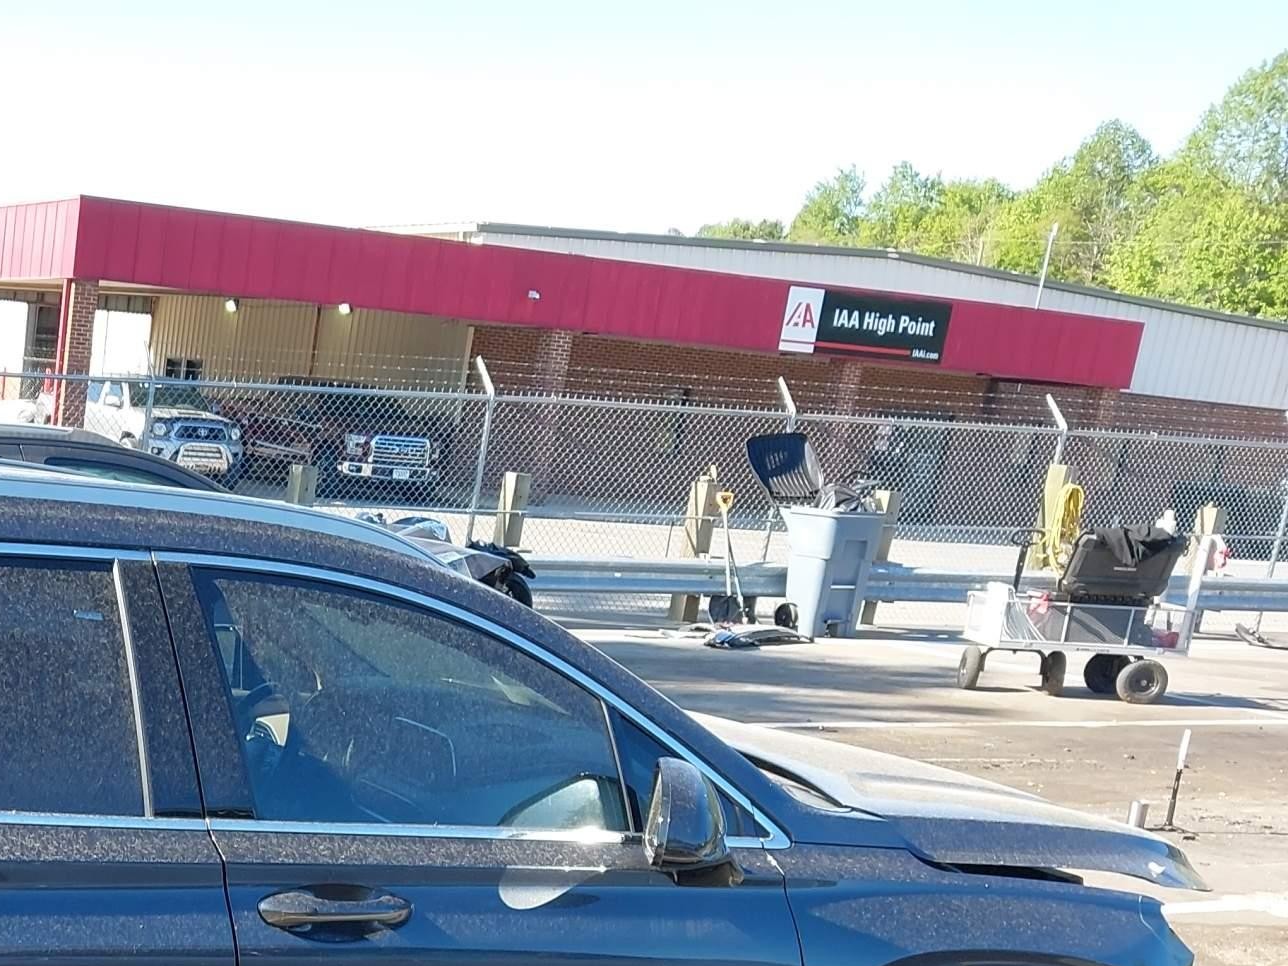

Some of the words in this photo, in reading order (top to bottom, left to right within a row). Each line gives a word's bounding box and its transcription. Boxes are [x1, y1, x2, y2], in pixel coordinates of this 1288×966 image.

[833, 308, 860, 330] IAA
[863, 311, 896, 337] High
[899, 315, 936, 337] Point
